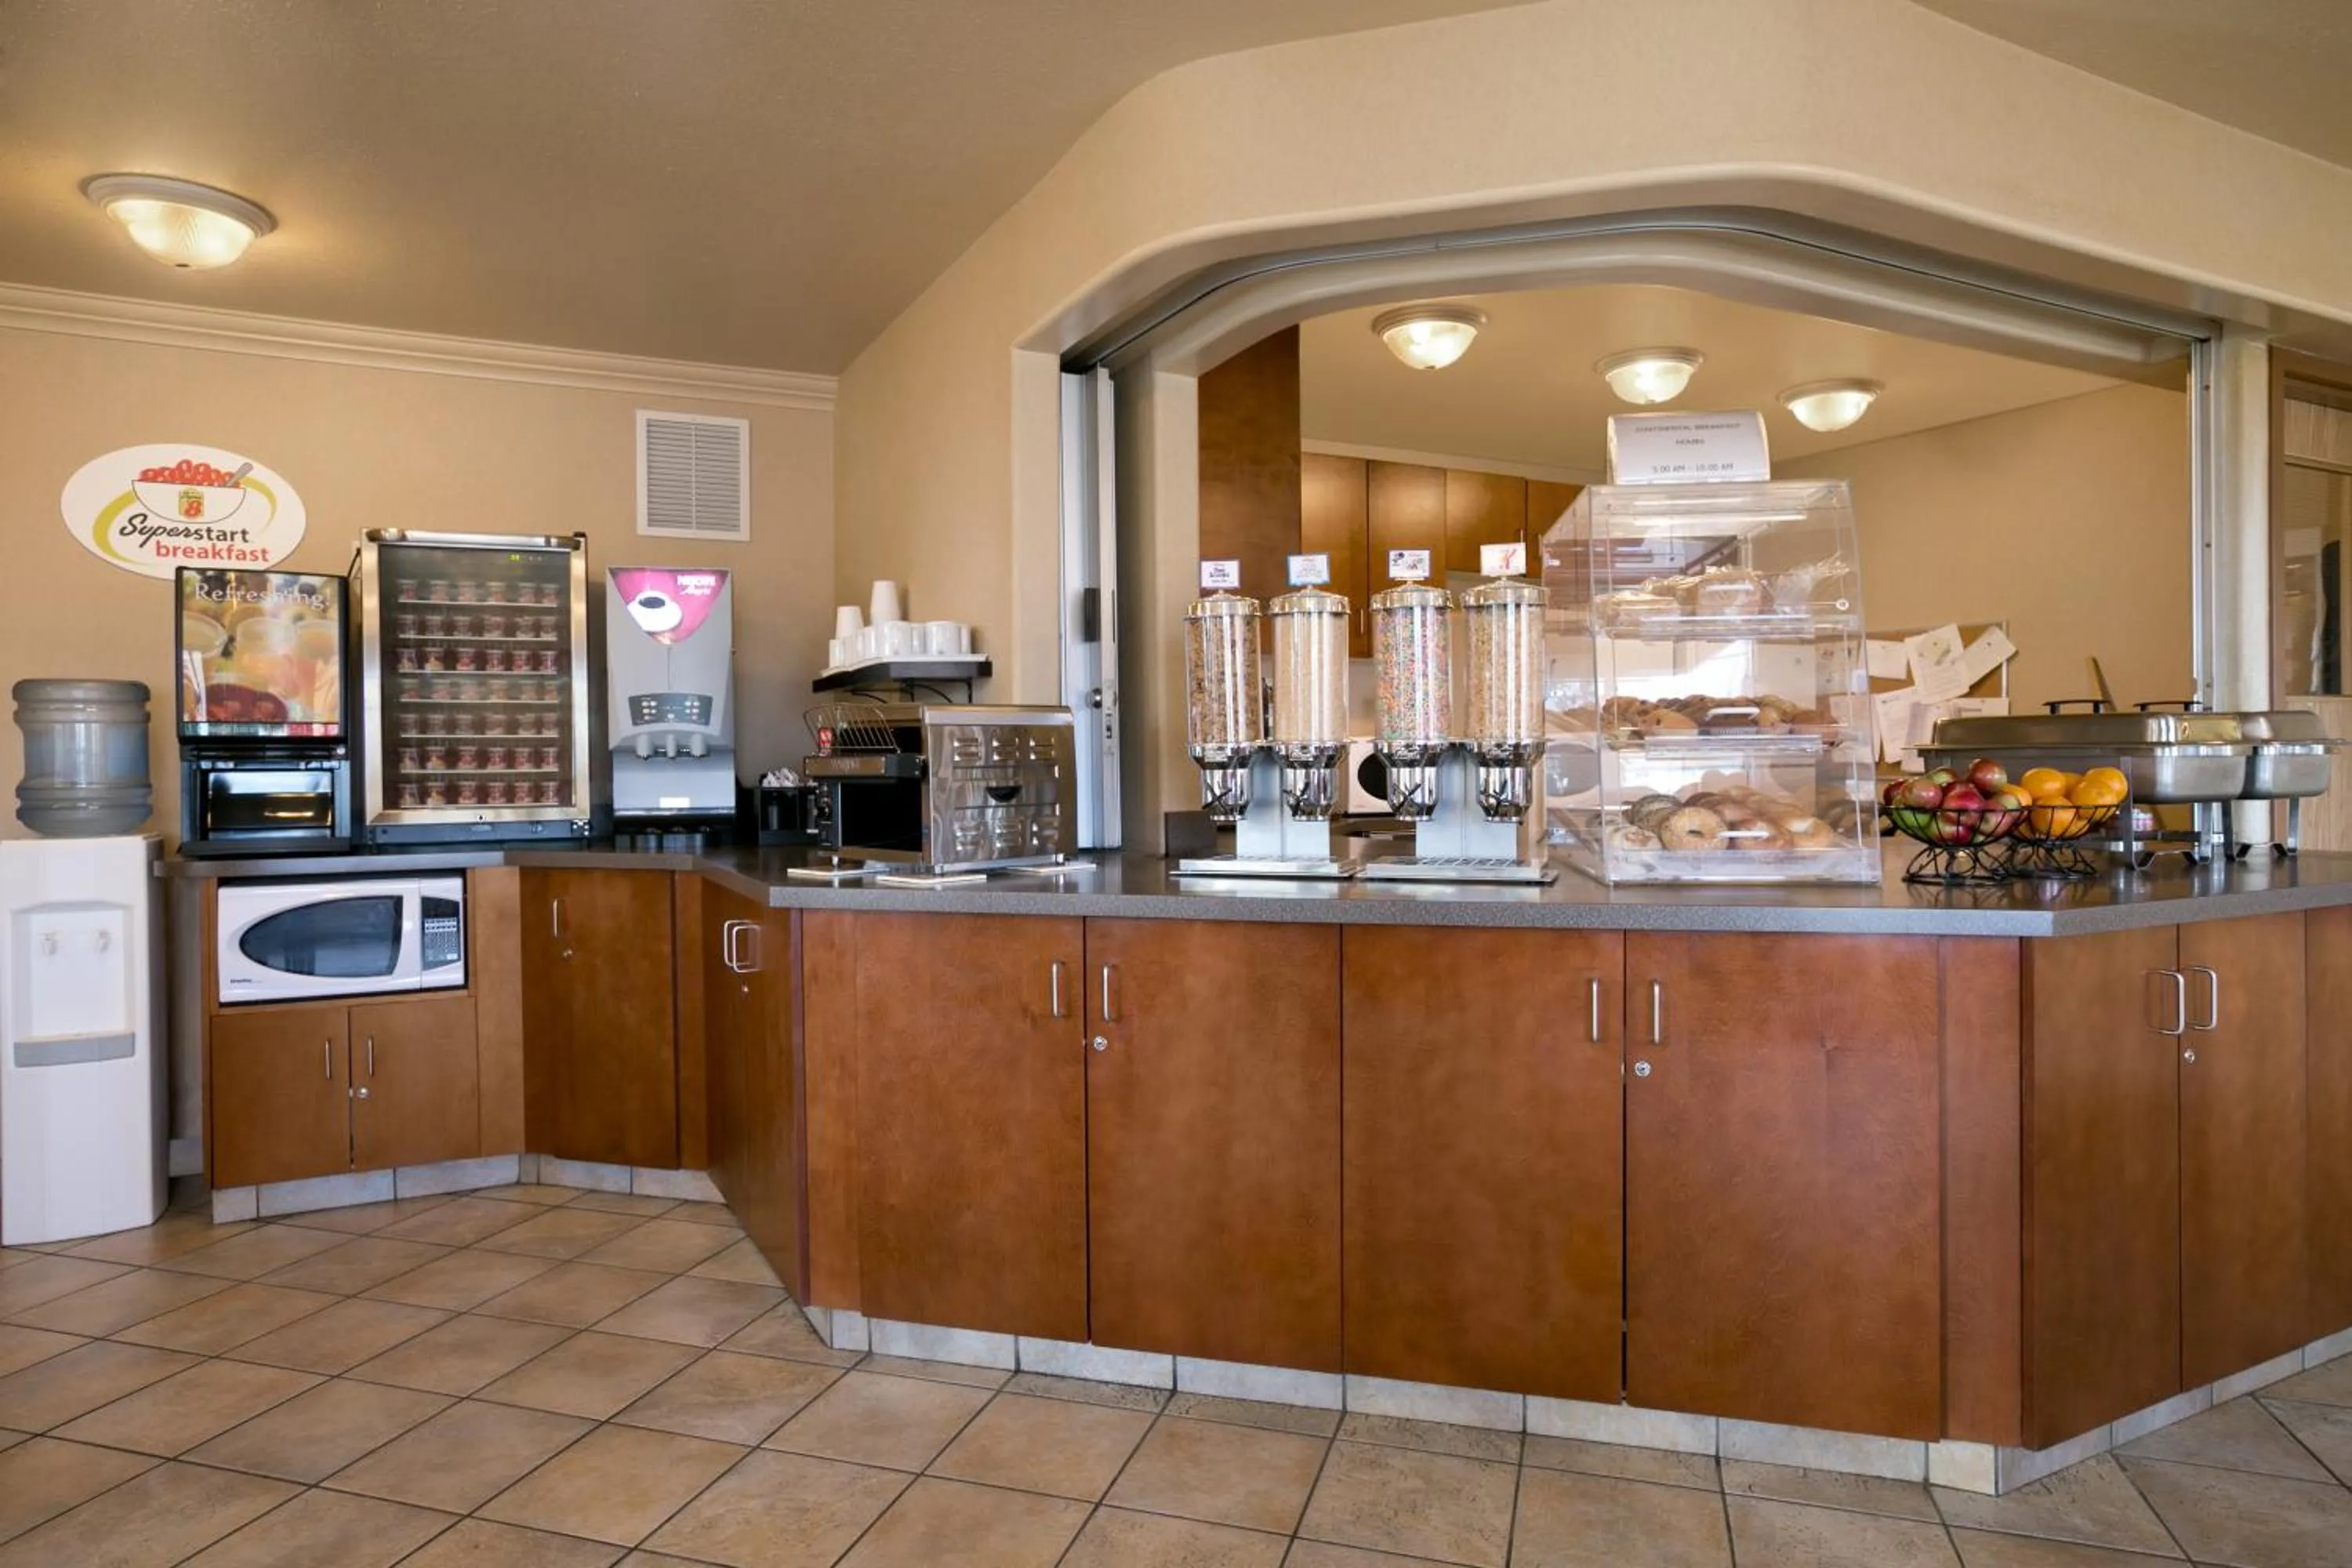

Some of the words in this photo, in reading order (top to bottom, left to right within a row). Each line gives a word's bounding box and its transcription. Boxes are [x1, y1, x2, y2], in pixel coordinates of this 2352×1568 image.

[184, 499, 201, 519] 8
[118, 512, 249, 548] Superstart
[155, 539, 269, 562] breakfast
[195, 583, 330, 609] Refreshing!
